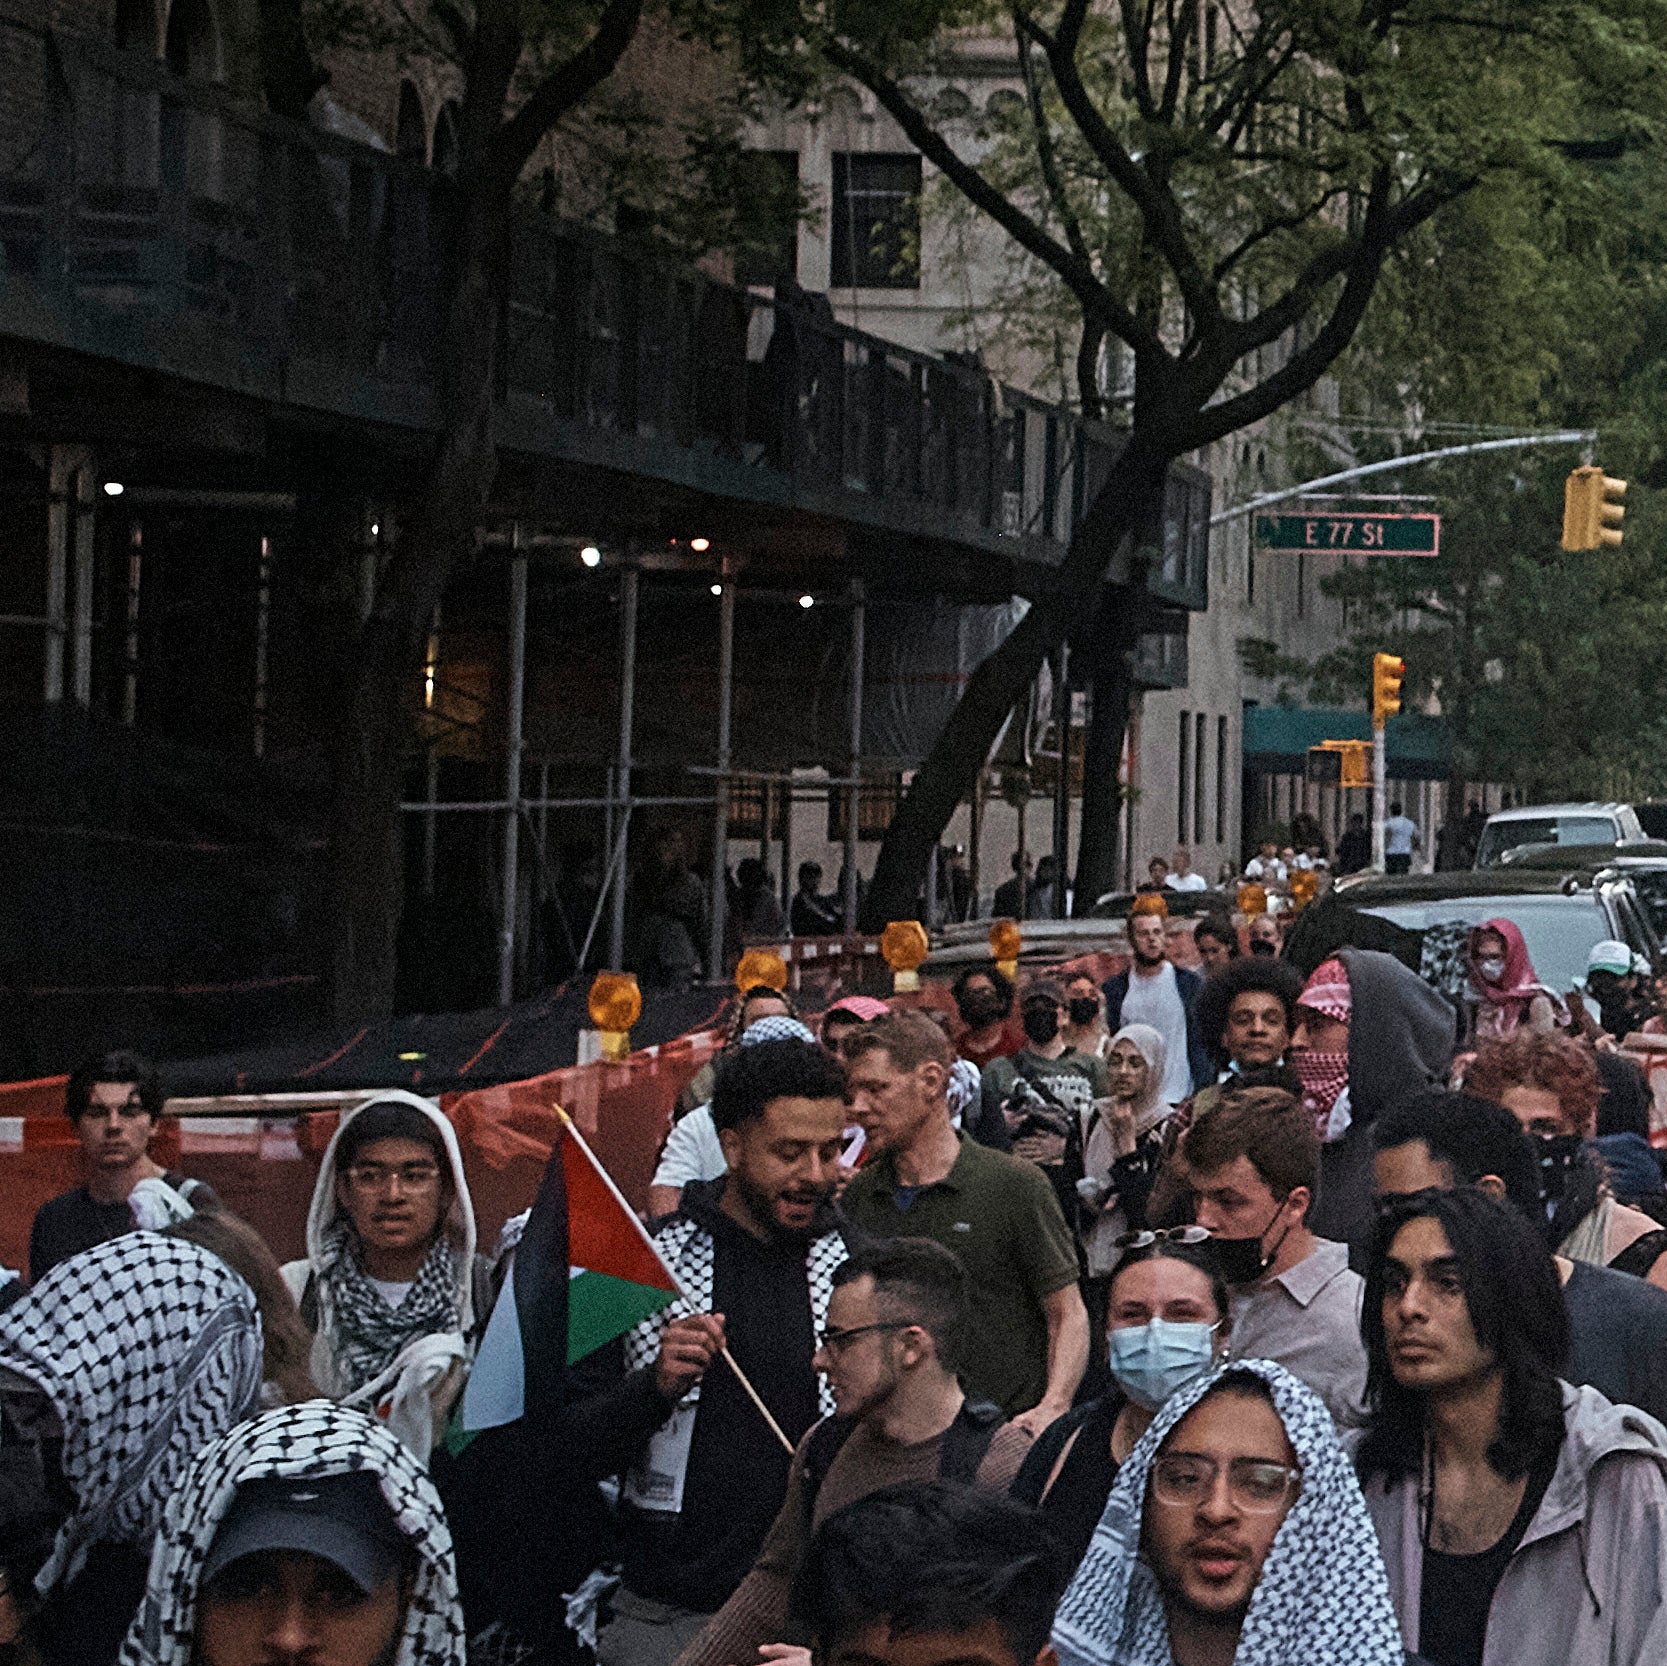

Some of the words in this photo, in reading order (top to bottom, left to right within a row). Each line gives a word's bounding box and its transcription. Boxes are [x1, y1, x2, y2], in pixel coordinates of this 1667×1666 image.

[1306, 522, 1319, 545] E
[1328, 522, 1354, 545] 77
[1362, 522, 1385, 546] St
